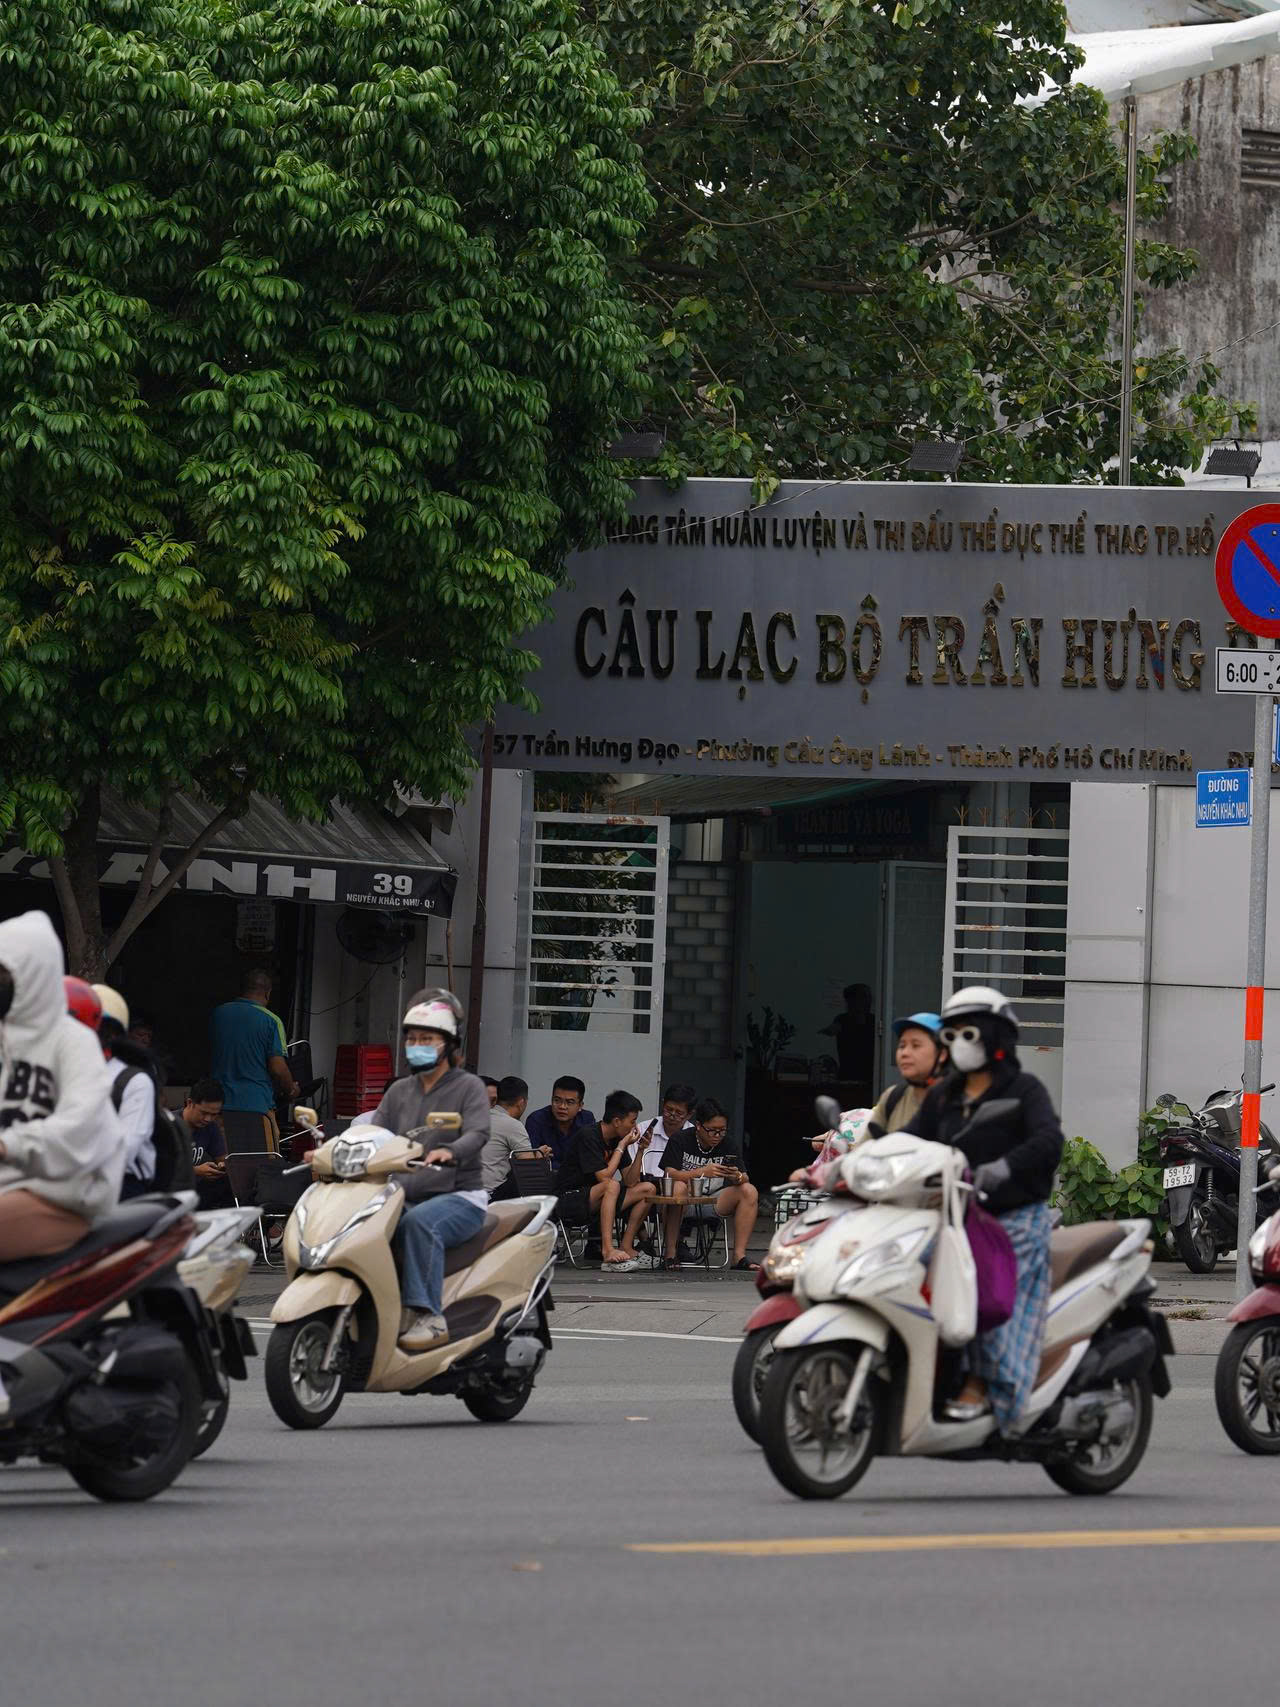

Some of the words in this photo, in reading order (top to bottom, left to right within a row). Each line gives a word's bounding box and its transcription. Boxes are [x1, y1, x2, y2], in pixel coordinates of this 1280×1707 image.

[664, 508, 706, 546] TÂM
[773, 511, 836, 557] LUYỆN
[842, 511, 868, 550] VÀ
[873, 520, 905, 551] THI
[911, 508, 953, 552] ĐẤU
[959, 507, 999, 552] THỂ
[1002, 523, 1042, 561] DỤC
[1049, 509, 1087, 554] THỂ
[1094, 524, 1148, 555] THAO
[575, 588, 678, 680] CÂU
[695, 610, 798, 701] LẠC
[815, 593, 882, 704] BỘ
[898, 582, 1044, 688] TRẦN
[1061, 607, 1205, 691] HƯNG
[1226, 662, 1258, 684] 6:00
[523, 729, 570, 756] Trần
[575, 736, 632, 763] Hưng
[638, 738, 680, 766] Đạo
[696, 738, 779, 768] Phường
[829, 735, 873, 771] Ông
[947, 743, 1015, 768] Thành
[1018, 741, 1060, 769] Phố
[1064, 743, 1093, 769] Hồ
[1099, 747, 1135, 770] Chí
[1138, 749, 1193, 771] Minh
[1207, 776, 1240, 793] ĐƯỜNG
[1236, 801, 1248, 818] NHU
[373, 873, 413, 896] 39
[1165, 1175, 1193, 1187] 195.32
